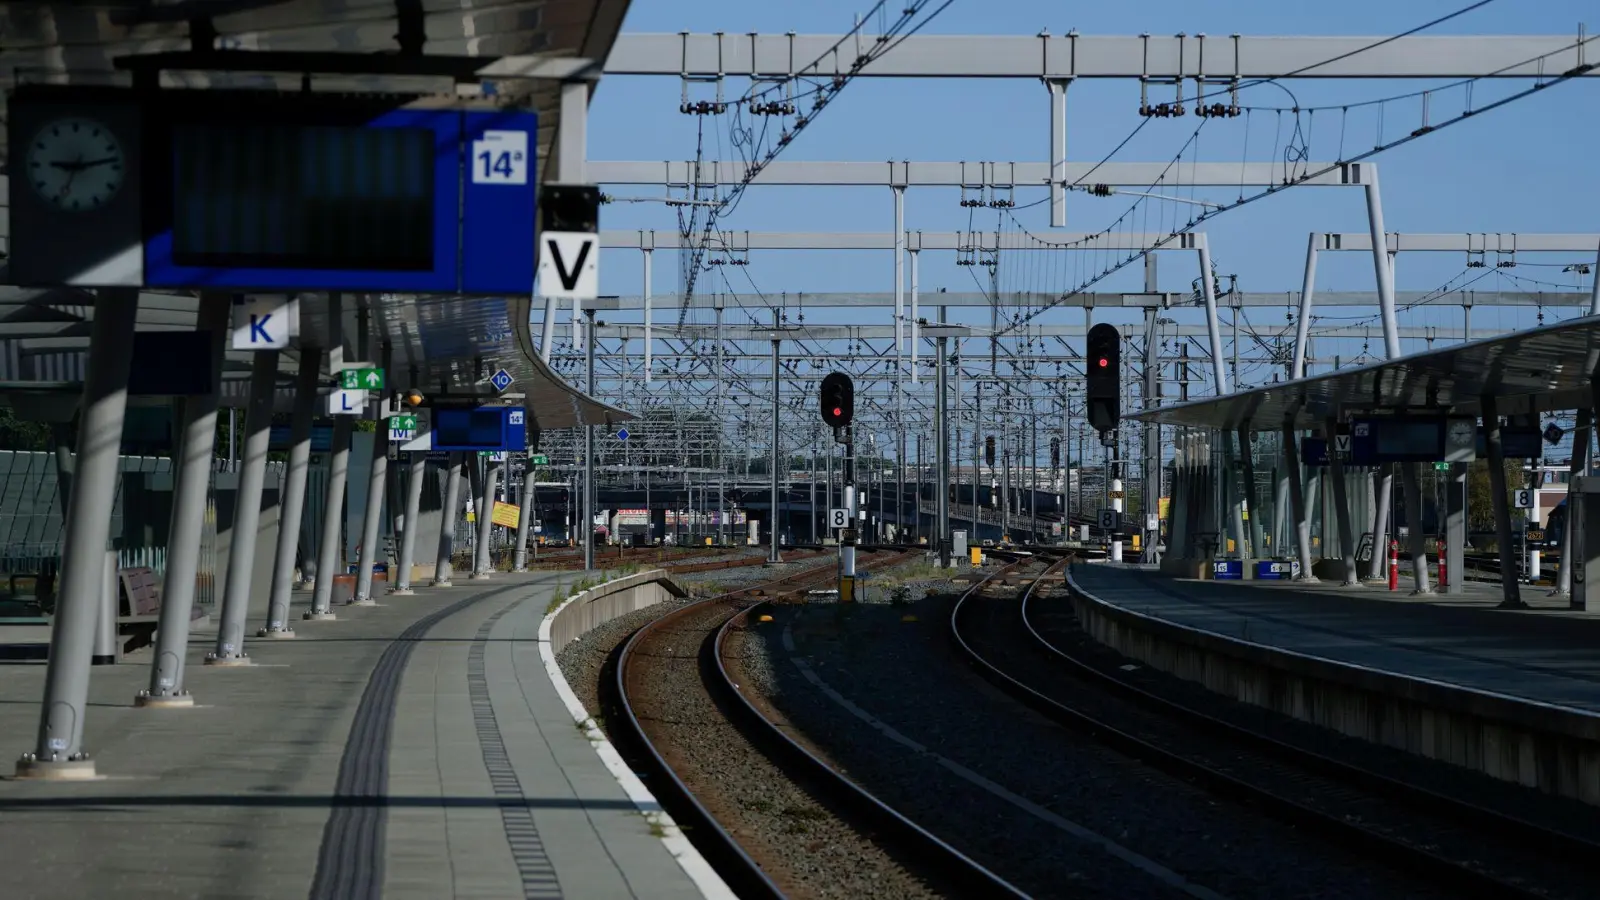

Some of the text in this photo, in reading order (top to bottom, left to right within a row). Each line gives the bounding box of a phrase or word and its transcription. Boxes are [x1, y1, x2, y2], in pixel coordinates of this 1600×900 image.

[547, 240, 592, 290] V
[250, 314, 273, 342] K
[496, 375, 508, 384] 10
[342, 393, 352, 410] L
[393, 429, 408, 438] M
[1338, 437, 1349, 449] V
[493, 451, 501, 459] N
[1519, 491, 1529, 505] 8
[835, 511, 844, 525] 8
[1102, 512, 1112, 527] 8
